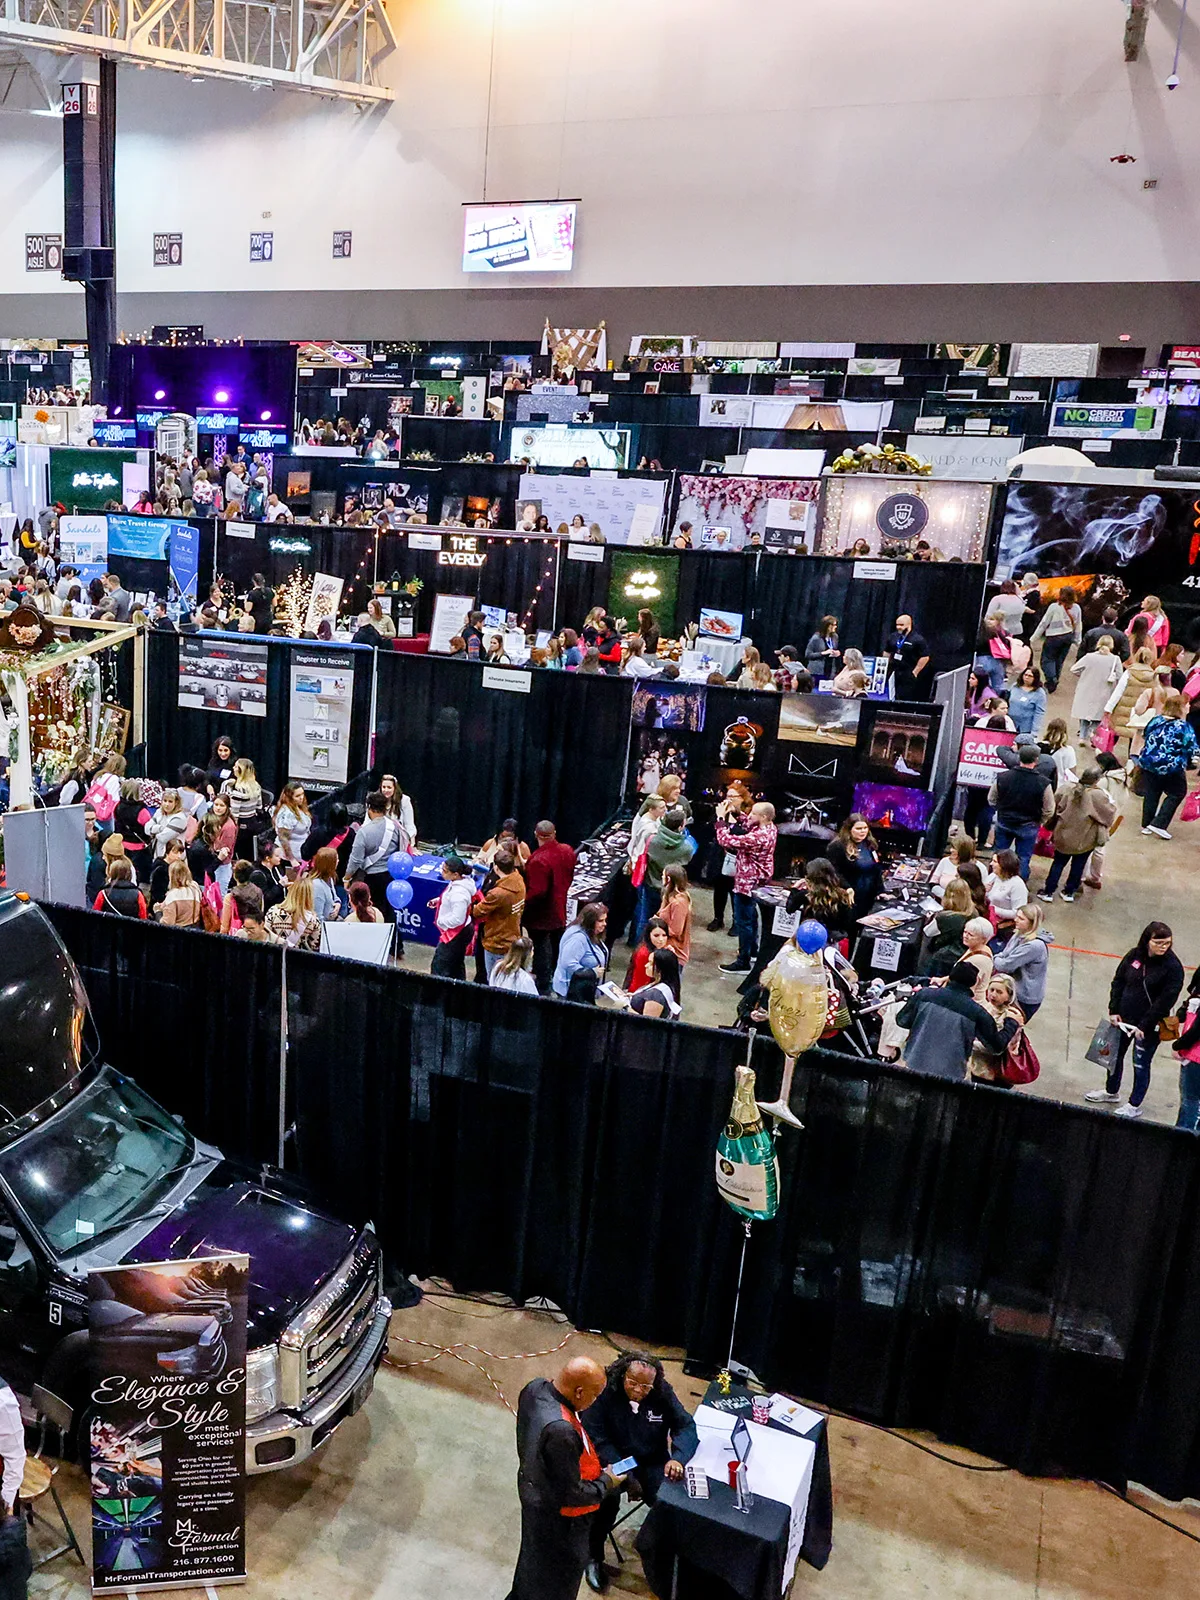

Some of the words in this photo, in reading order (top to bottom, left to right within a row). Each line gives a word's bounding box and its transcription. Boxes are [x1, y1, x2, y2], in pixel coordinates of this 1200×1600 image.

[68, 87, 75, 97] Y
[65, 101, 79, 111] 26
[27, 237, 43, 253] 500
[154, 236, 167, 250] 600
[251, 234, 261, 247] 700
[27, 257, 44, 268] AISLE
[155, 253, 168, 263] AISLE
[653, 362, 680, 371] CAKE
[1064, 409, 1089, 421] NO
[66, 522, 101, 534] Sandals
[128, 519, 147, 527] Travel
[147, 521, 168, 530] Group
[450, 536, 476, 551] THE
[439, 552, 486, 566] EVERLY
[296, 655, 319, 664] Register
[327, 658, 350, 666] Receive
[964, 741, 999, 756] CAK
[771, 986, 806, 1018] Cheers
[52, 1305, 60, 1323] 5
[151, 1375, 185, 1384] Where
[91, 1376, 209, 1410] Elegance
[216, 1367, 246, 1395] &
[147, 1399, 229, 1433] Style
[205, 1424, 229, 1432] meet
[188, 1428, 242, 1442] exceptional
[196, 1438, 234, 1448] services
[178, 1493, 202, 1501] Carrying
[176, 1518, 199, 1533] Mr.
[168, 1526, 240, 1547] Formal
[181, 1542, 239, 1555] Transportation
[173, 1554, 235, 1566] 216.877.1600
[104, 1566, 235, 1583] MrFormalTransportation.com
